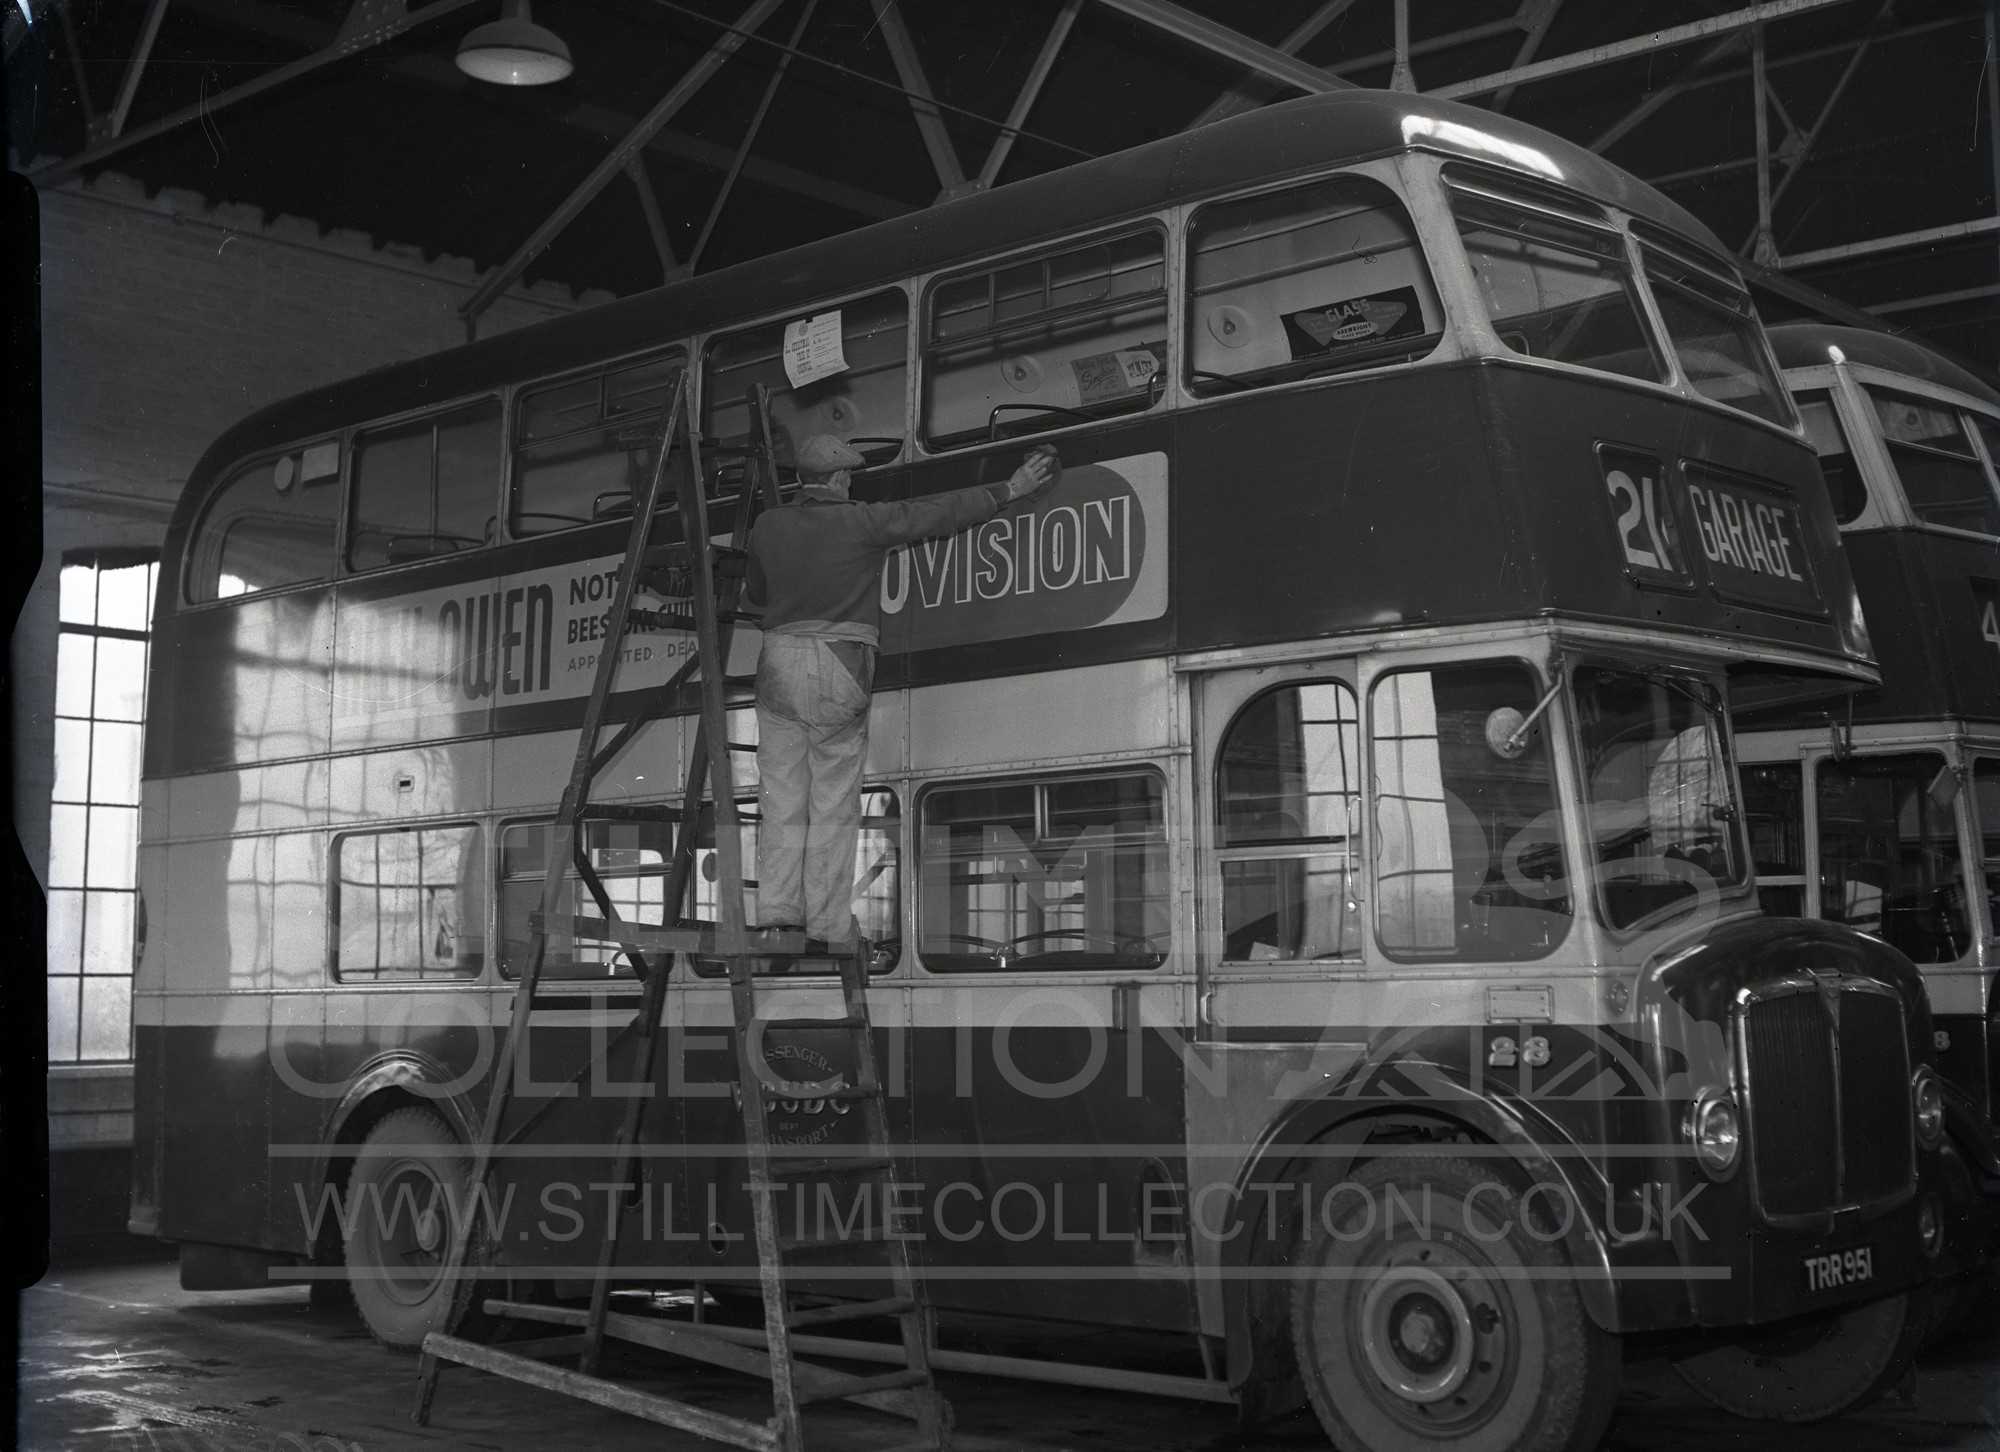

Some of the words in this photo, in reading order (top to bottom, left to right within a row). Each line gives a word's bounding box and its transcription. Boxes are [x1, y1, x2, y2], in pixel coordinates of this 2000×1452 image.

[1325, 298, 1370, 322] GLASS
[1689, 484, 1803, 582] GARAGE
[567, 646, 652, 672] APPTED
[1488, 1035, 1551, 1067] 28
